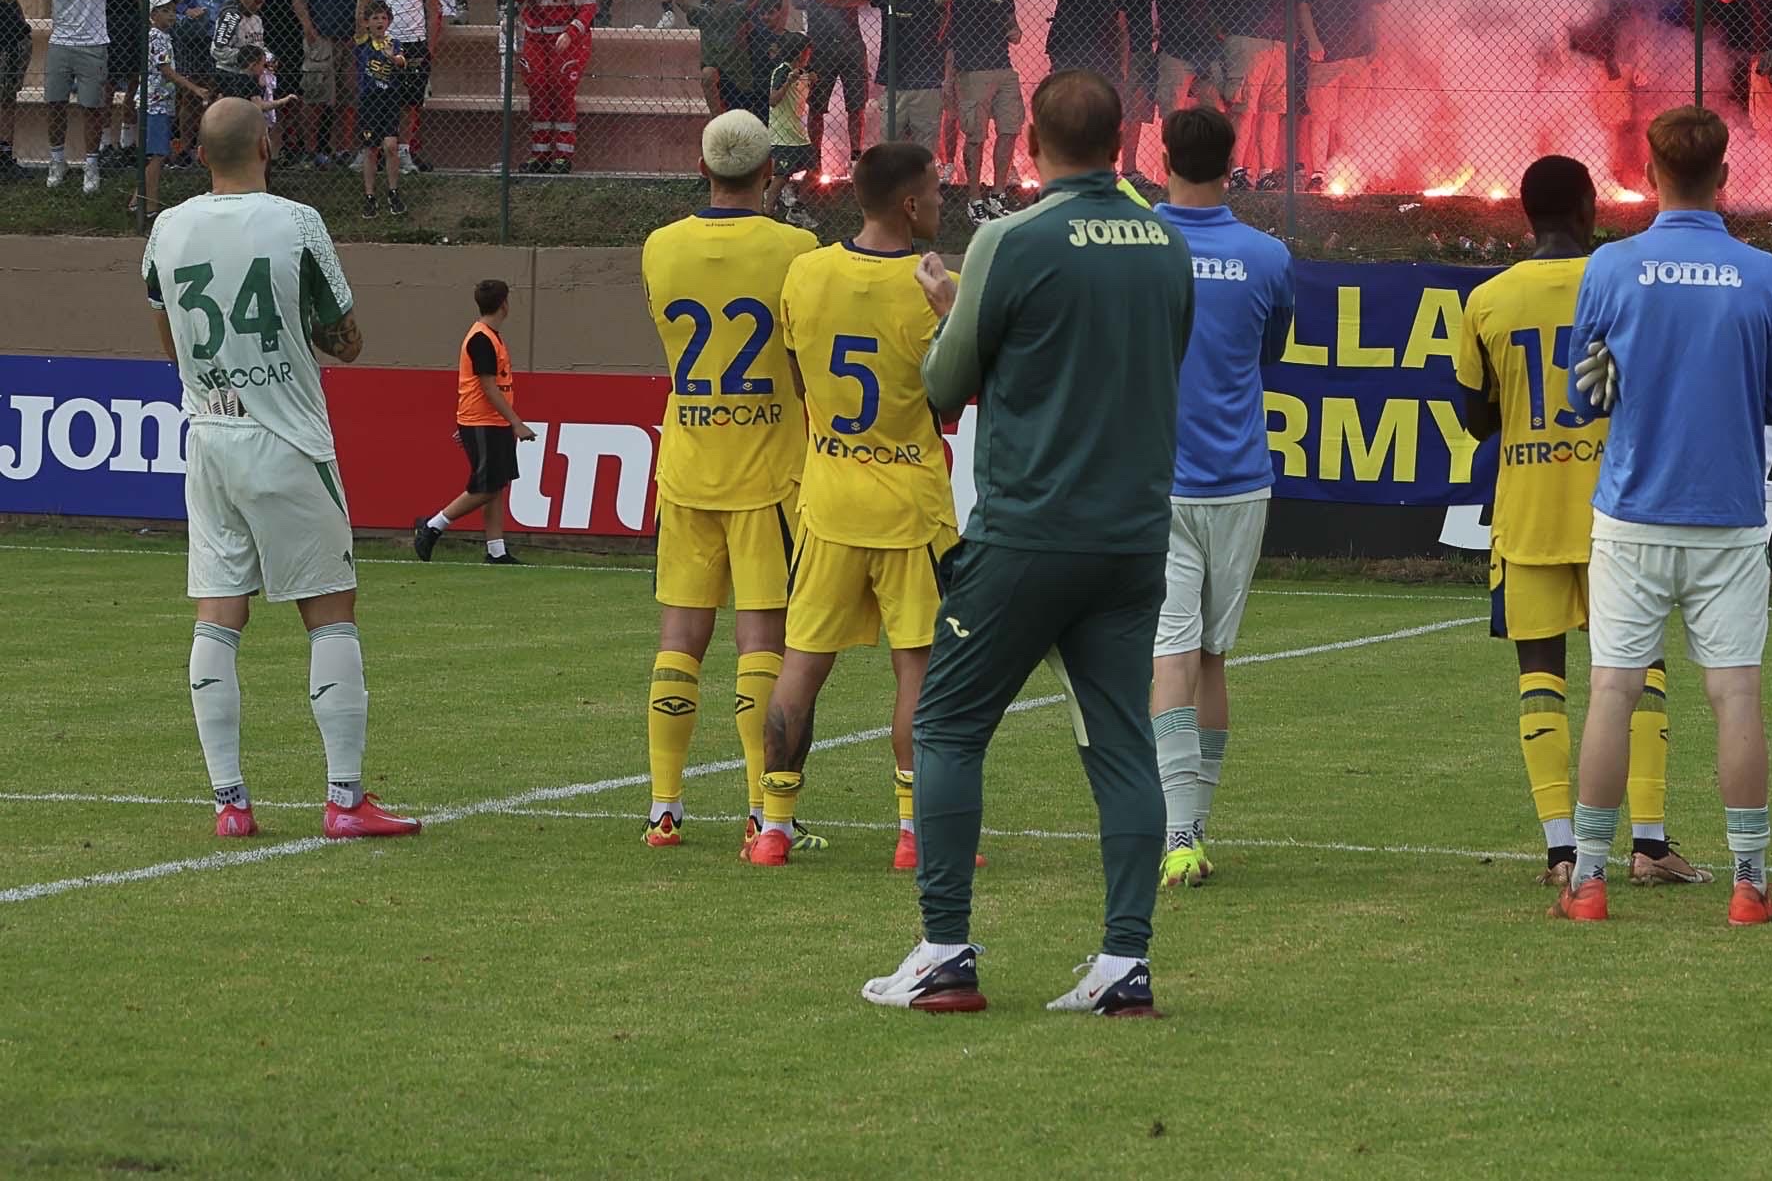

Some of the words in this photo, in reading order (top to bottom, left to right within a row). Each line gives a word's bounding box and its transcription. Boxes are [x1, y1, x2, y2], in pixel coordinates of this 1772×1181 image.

[1069, 219, 1169, 247] Joma
[1639, 261, 1744, 288] Joma
[174, 257, 284, 360] 34
[664, 296, 775, 396] 22
[1280, 286, 1465, 369] LLA
[679, 404, 783, 427] ETROCAR
[829, 334, 880, 436] 5
[1264, 389, 1481, 484] RMY
[1504, 439, 1606, 467] VETROCA
